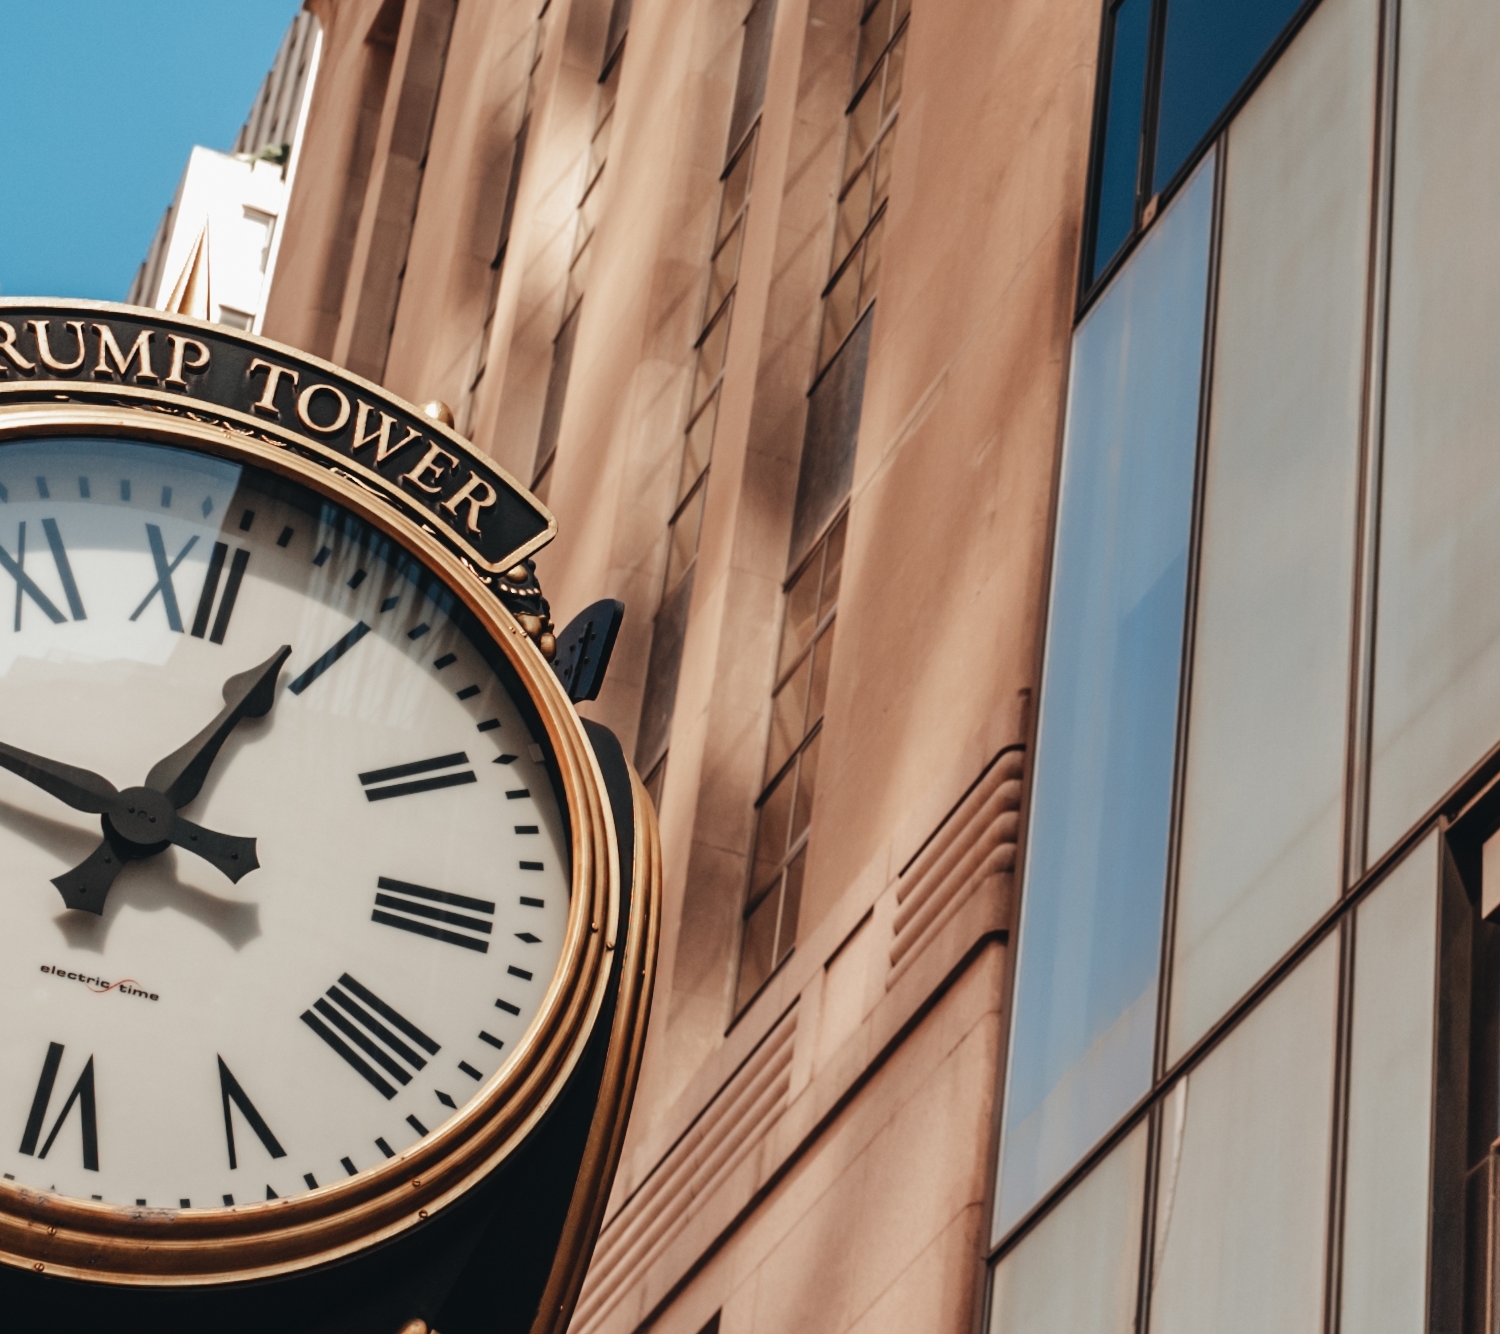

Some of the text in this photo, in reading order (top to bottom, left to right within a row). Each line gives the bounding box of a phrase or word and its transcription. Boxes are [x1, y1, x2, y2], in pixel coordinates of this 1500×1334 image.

[250, 357, 498, 537] TOWER
[129, 523, 250, 646] XII
[288, 621, 373, 696] I
[358, 751, 477, 801] II
[371, 876, 496, 953] III
[40, 965, 160, 1002] electric time
[300, 972, 441, 1100] IIII
[19, 1041, 98, 1171] VI
[217, 1053, 288, 1170] V
